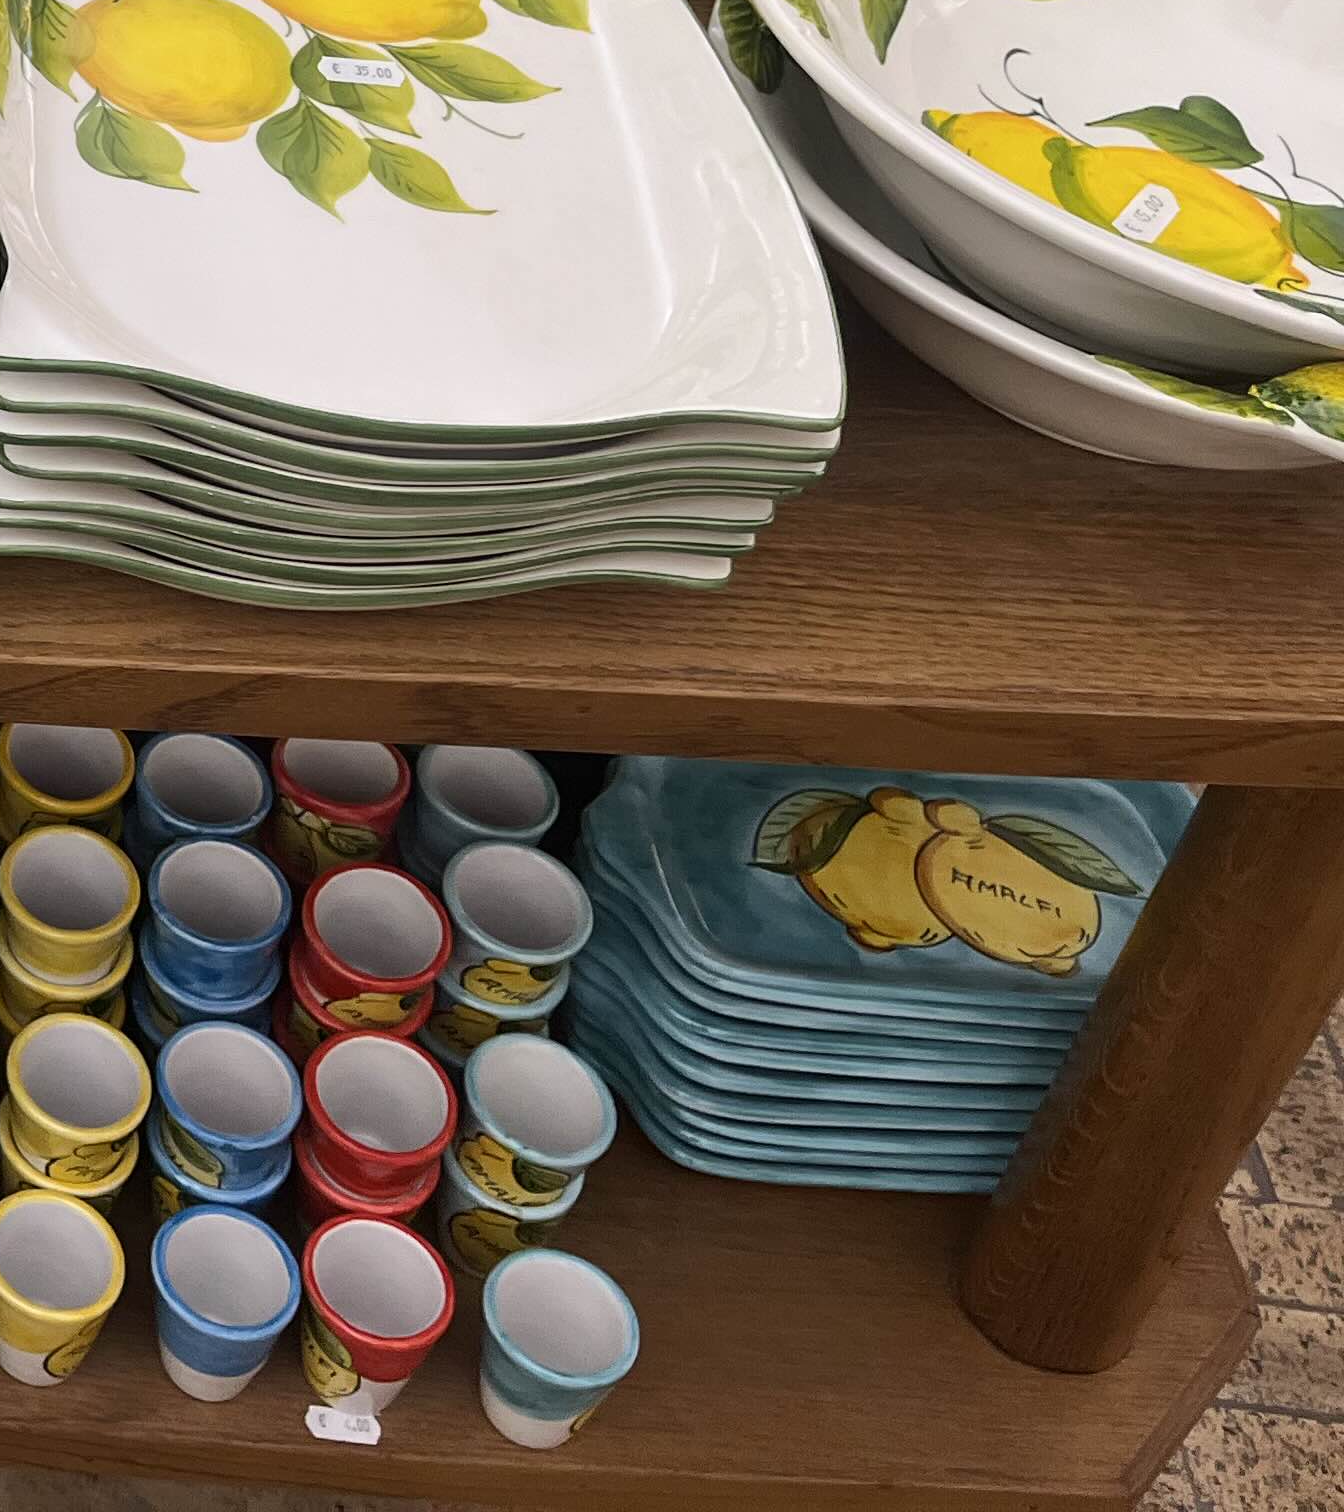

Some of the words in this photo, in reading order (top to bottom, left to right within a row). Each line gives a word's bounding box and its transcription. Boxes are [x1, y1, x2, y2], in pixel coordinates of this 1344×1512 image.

[331, 62, 341, 74] €
[354, 64, 393, 79] 35.00
[950, 866, 1062, 920] AMALFI
